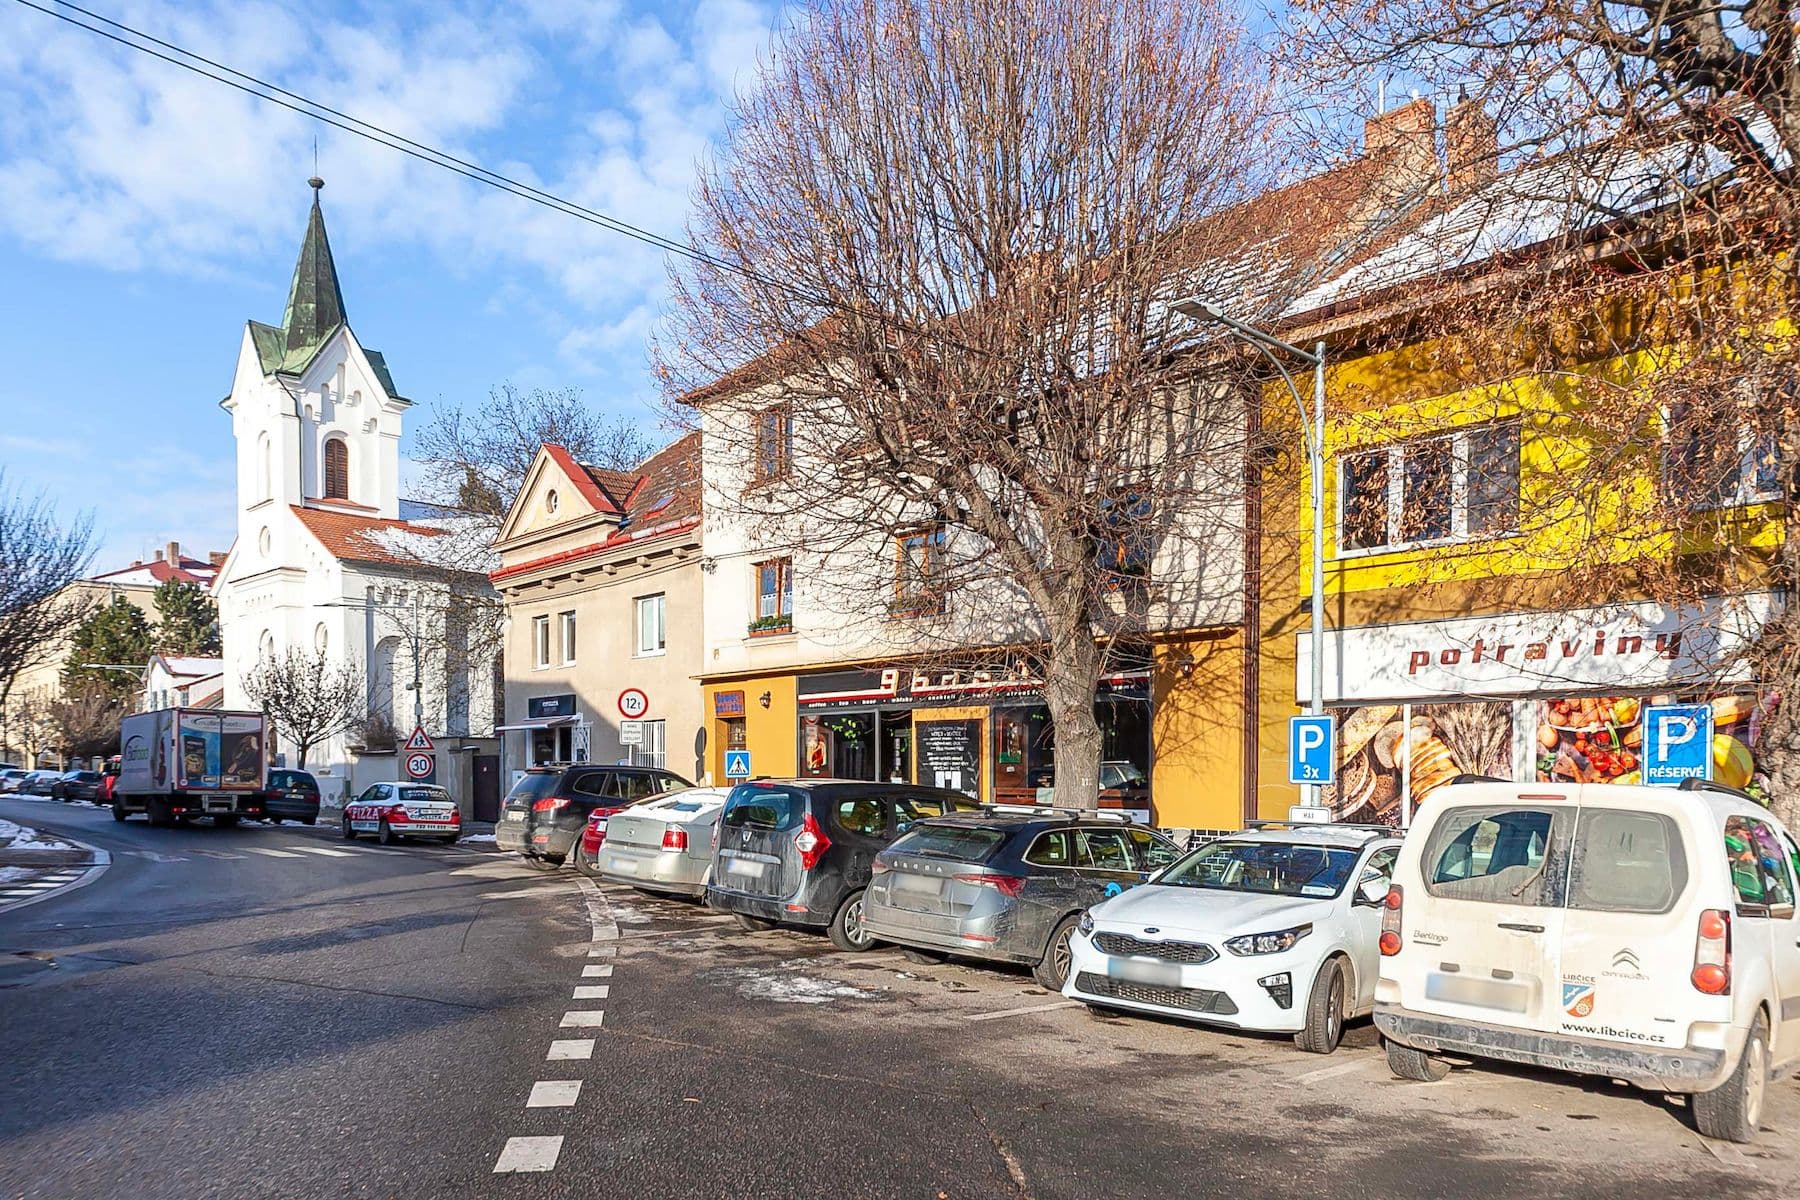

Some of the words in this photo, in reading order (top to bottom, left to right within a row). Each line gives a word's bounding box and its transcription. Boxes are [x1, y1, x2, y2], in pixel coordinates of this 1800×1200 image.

[1409, 631, 1683, 675] potraviny
[1298, 724, 1325, 763] P
[1658, 715, 1698, 762] P
[411, 759, 428, 771] 30
[1302, 764, 1320, 779] 3x
[1648, 765, 1705, 778] RÉSERVÉ
[351, 806, 380, 820] PIZZA
[1413, 930, 1449, 942] Berlingo
[1562, 973, 1596, 983] LIBČICE
[1562, 1022, 1666, 1043] www.libcice.cz
